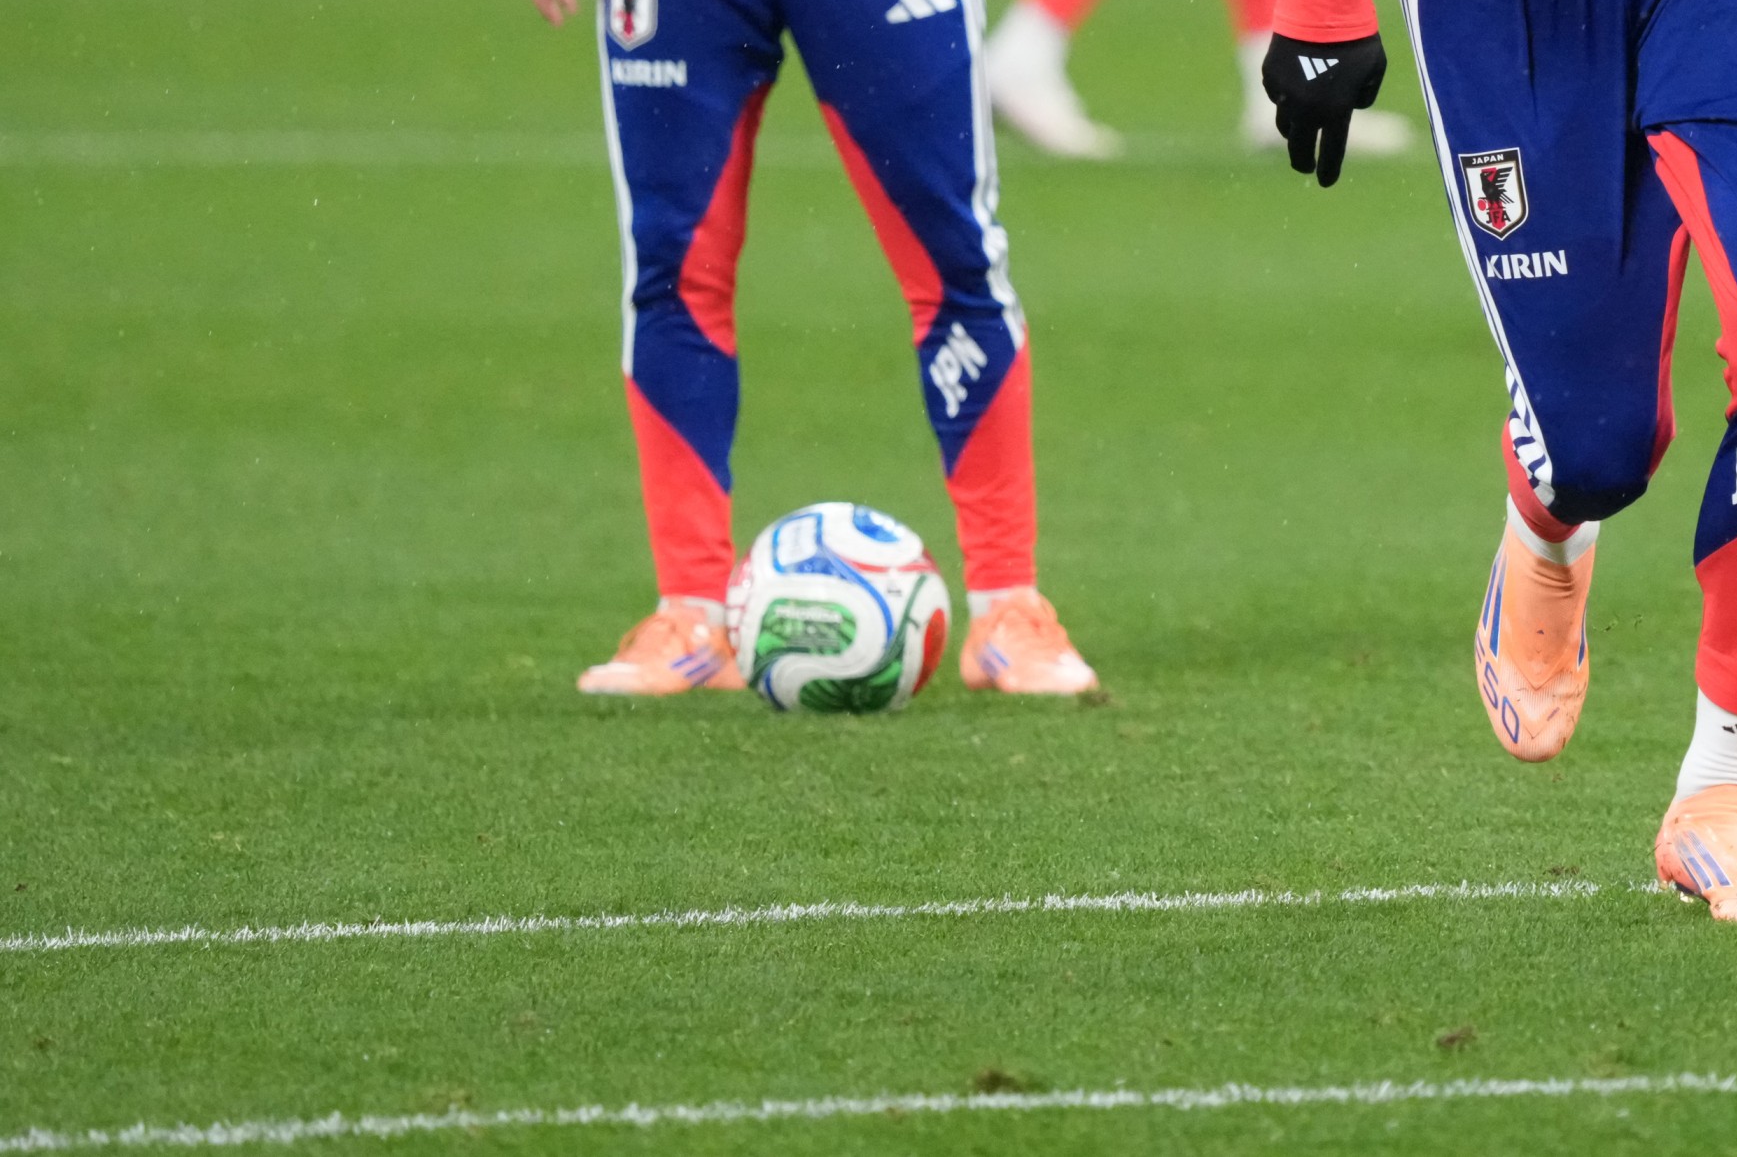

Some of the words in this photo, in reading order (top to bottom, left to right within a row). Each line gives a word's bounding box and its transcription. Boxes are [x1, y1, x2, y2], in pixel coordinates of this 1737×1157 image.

[1472, 154, 1504, 165] JAPAN
[1486, 210, 1511, 224] JFA
[1485, 250, 1568, 280] KIRIN
[929, 321, 988, 419] JPN
